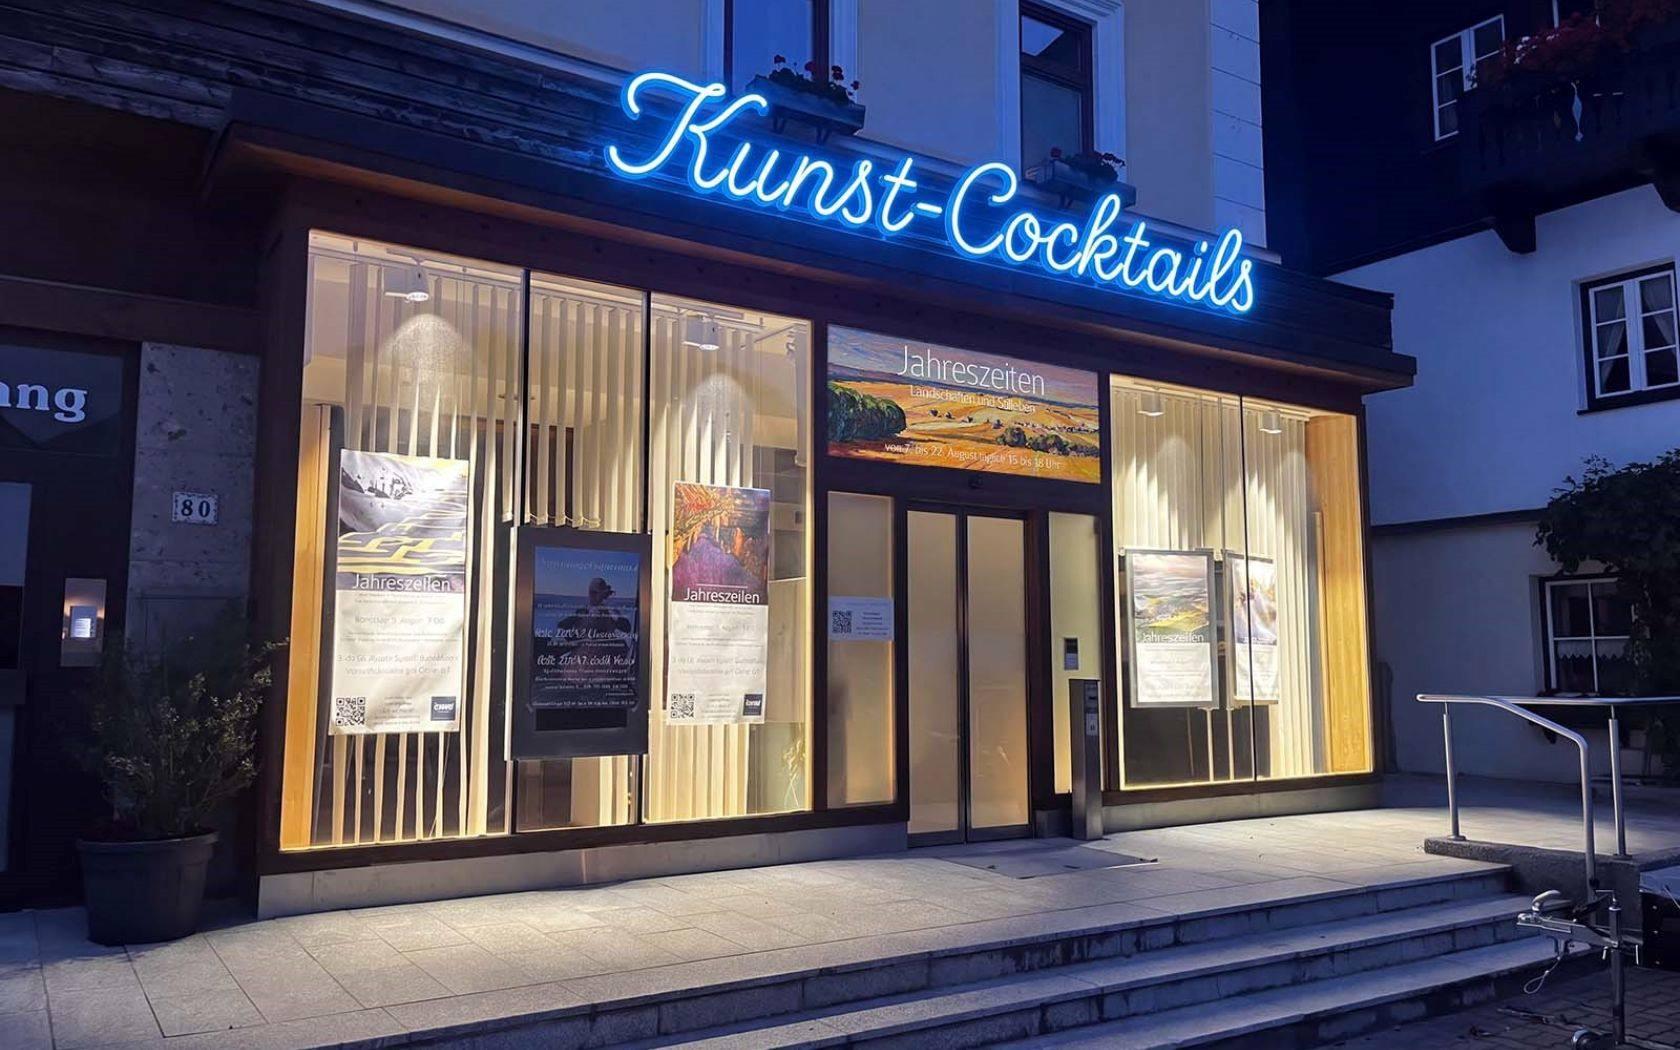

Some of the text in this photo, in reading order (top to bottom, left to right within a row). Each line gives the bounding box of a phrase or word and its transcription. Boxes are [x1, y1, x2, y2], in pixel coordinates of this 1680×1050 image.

[605, 71, 1255, 313] Kunst-Cocktails
[898, 344, 1046, 396] Jahreszeiten
[181, 499, 211, 518] 80
